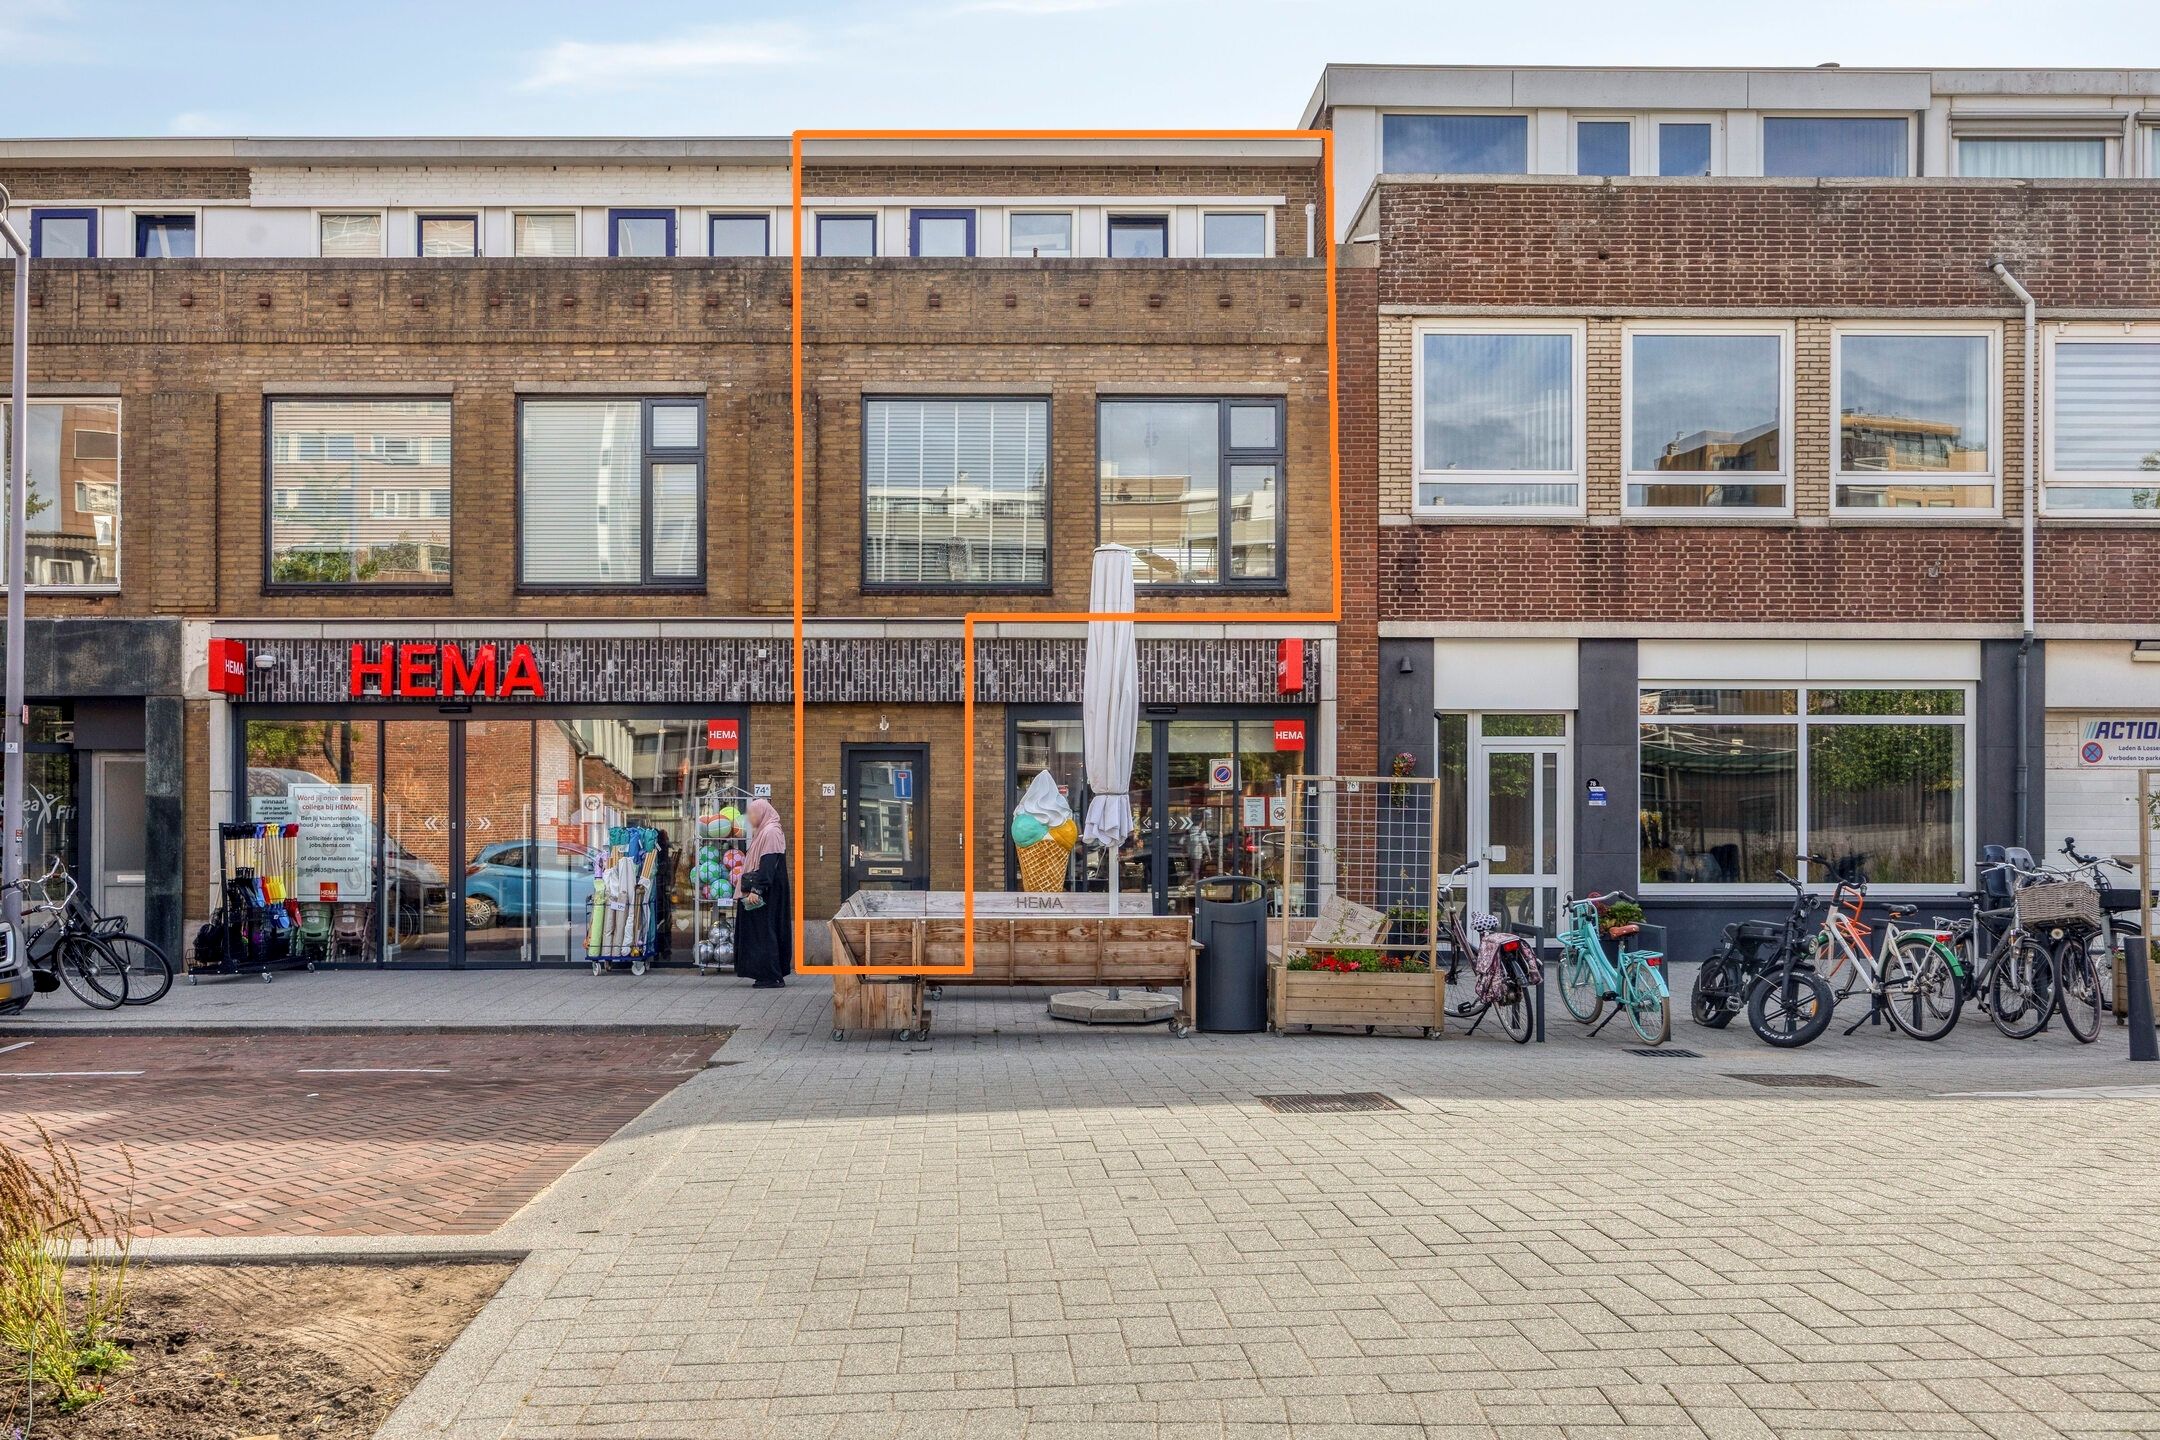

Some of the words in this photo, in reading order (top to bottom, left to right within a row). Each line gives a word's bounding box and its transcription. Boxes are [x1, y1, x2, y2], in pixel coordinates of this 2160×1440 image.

[225, 659, 245, 676] HEMA
[351, 643, 546, 697] HEMA
[709, 730, 738, 739] HEMA
[1275, 731, 1304, 740] HEMA
[2094, 721, 2160, 740] ACTIO
[56, 804, 77, 820] Fit
[302, 803, 325, 811] collega
[1016, 896, 1064, 909] HEMA
[1759, 1026, 1793, 1040] KENDA
